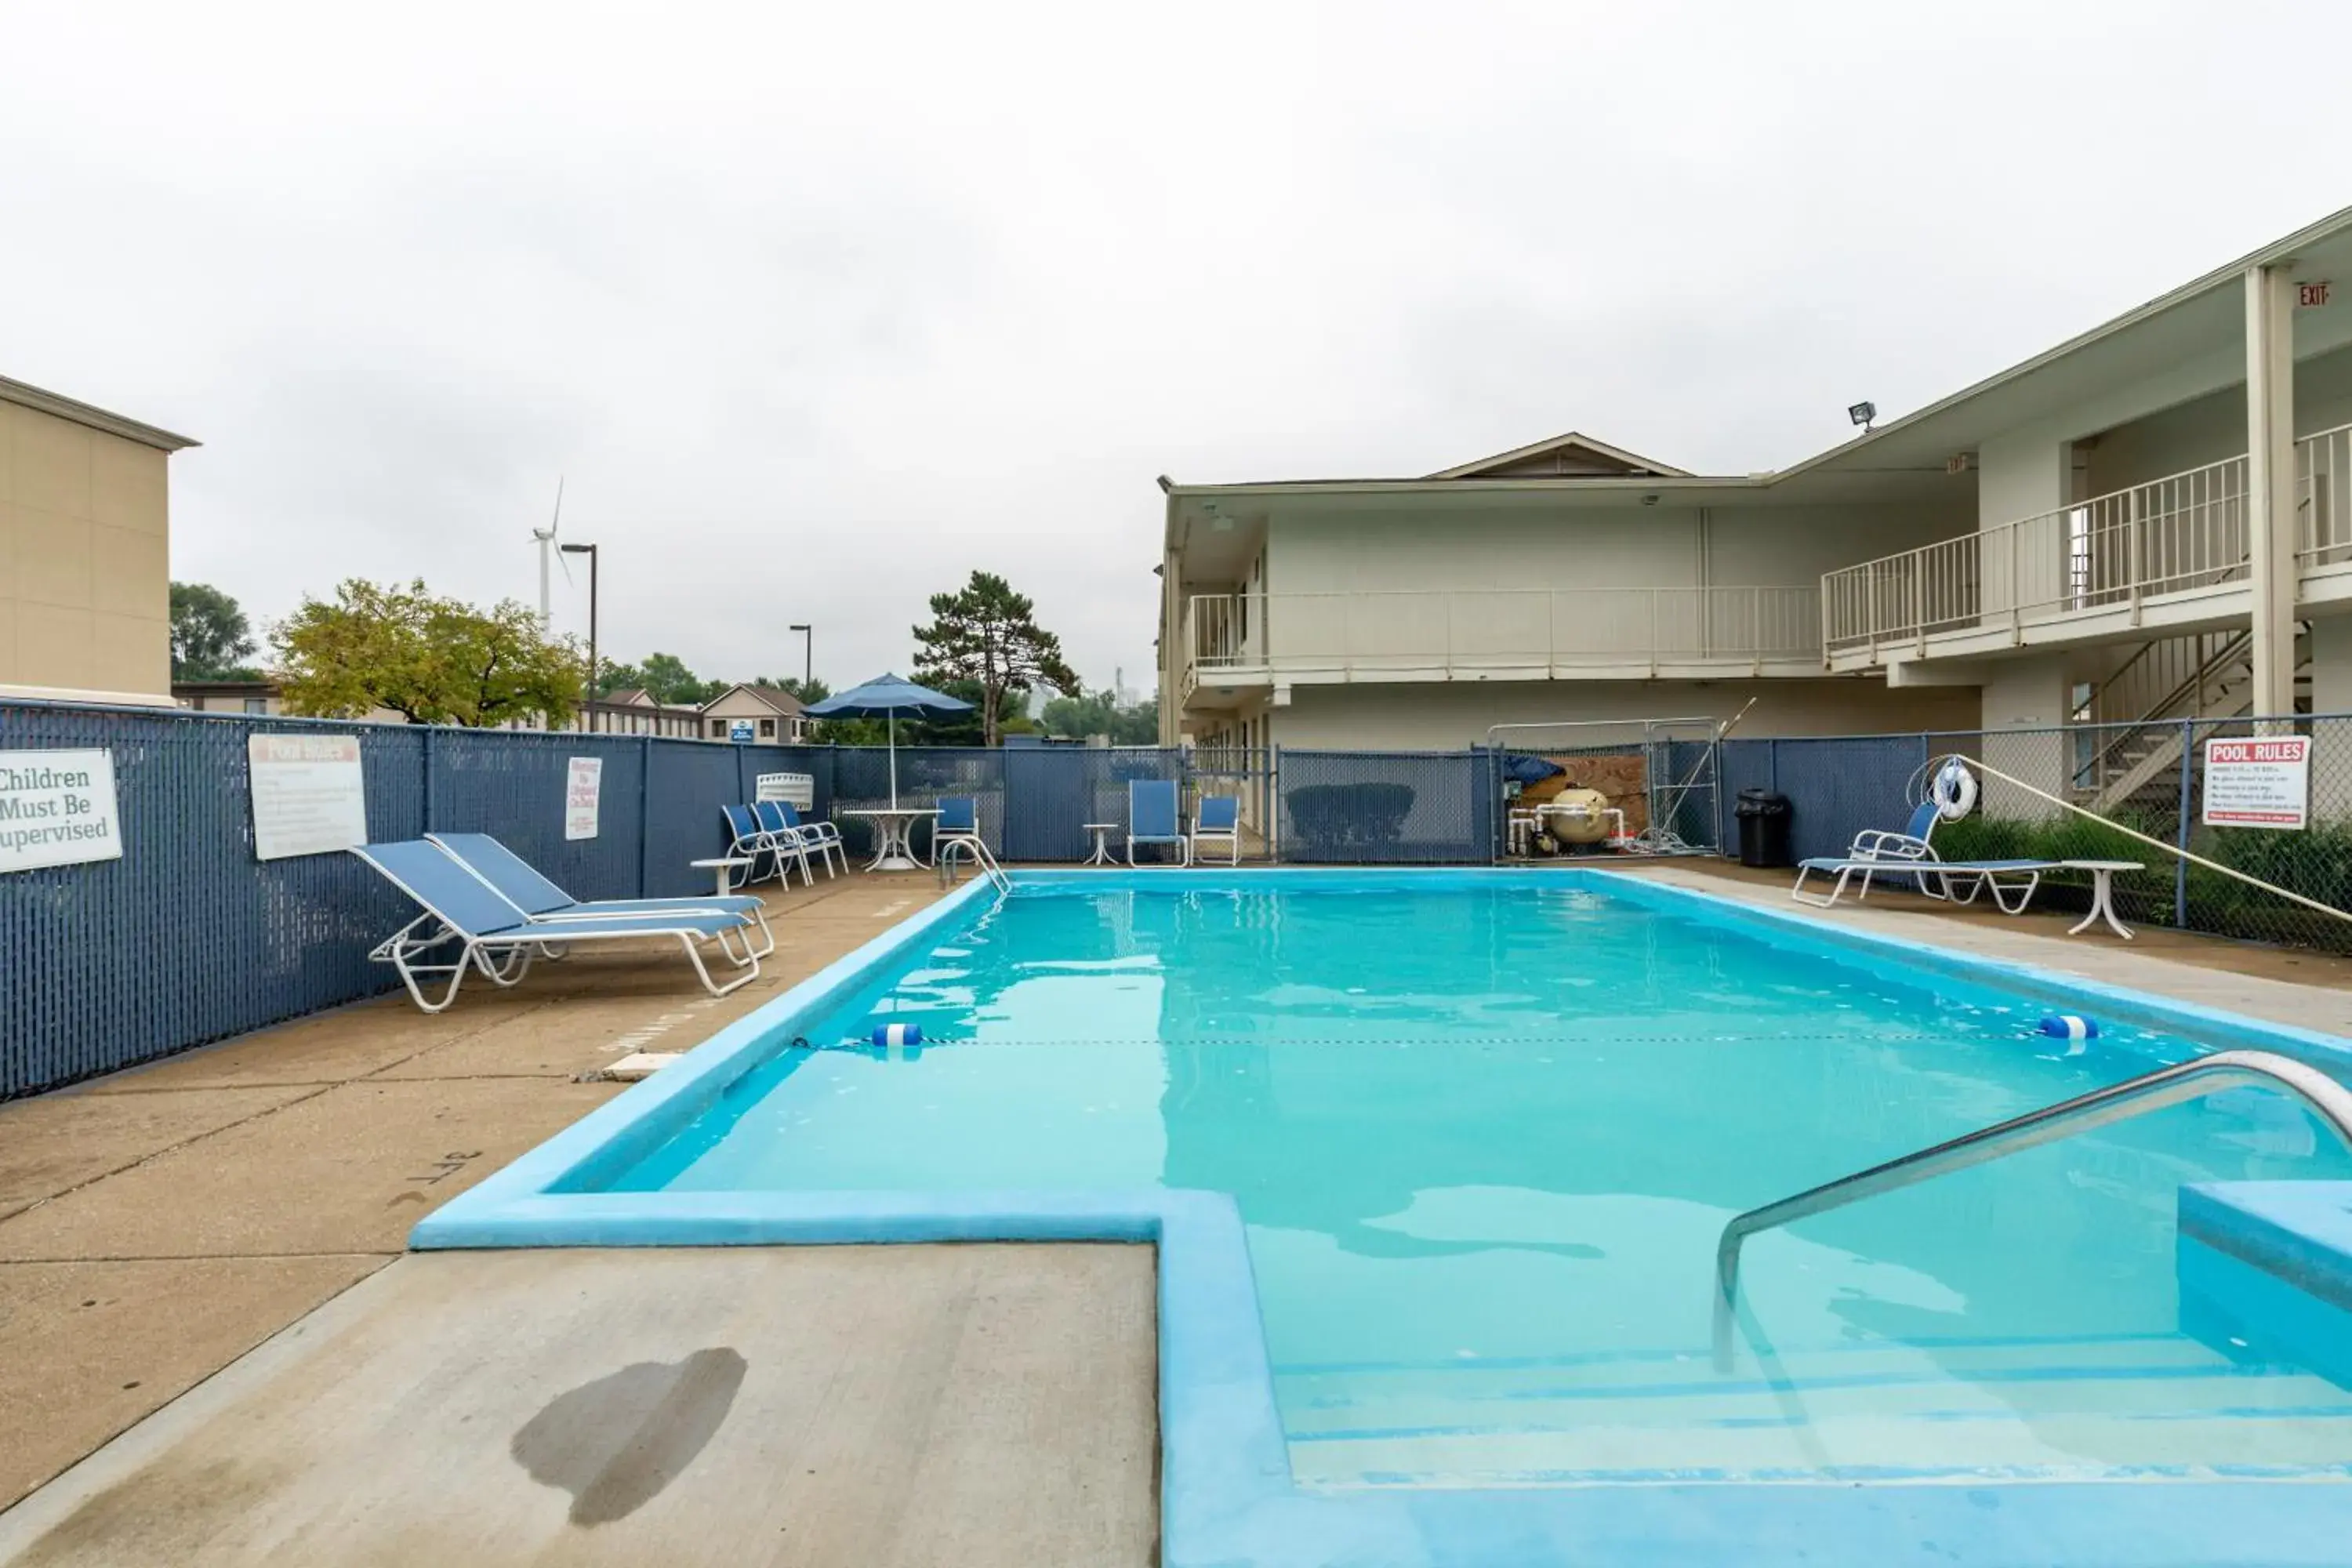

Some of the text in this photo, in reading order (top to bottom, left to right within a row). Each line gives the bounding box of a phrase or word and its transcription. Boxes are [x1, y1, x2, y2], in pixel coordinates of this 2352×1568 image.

[2299, 285, 2326, 306] EXIT
[2212, 743, 2301, 761] POOL RULES
[0, 768, 90, 791] Children
[0, 794, 91, 820] Must Be
[0, 817, 108, 852] upervised
